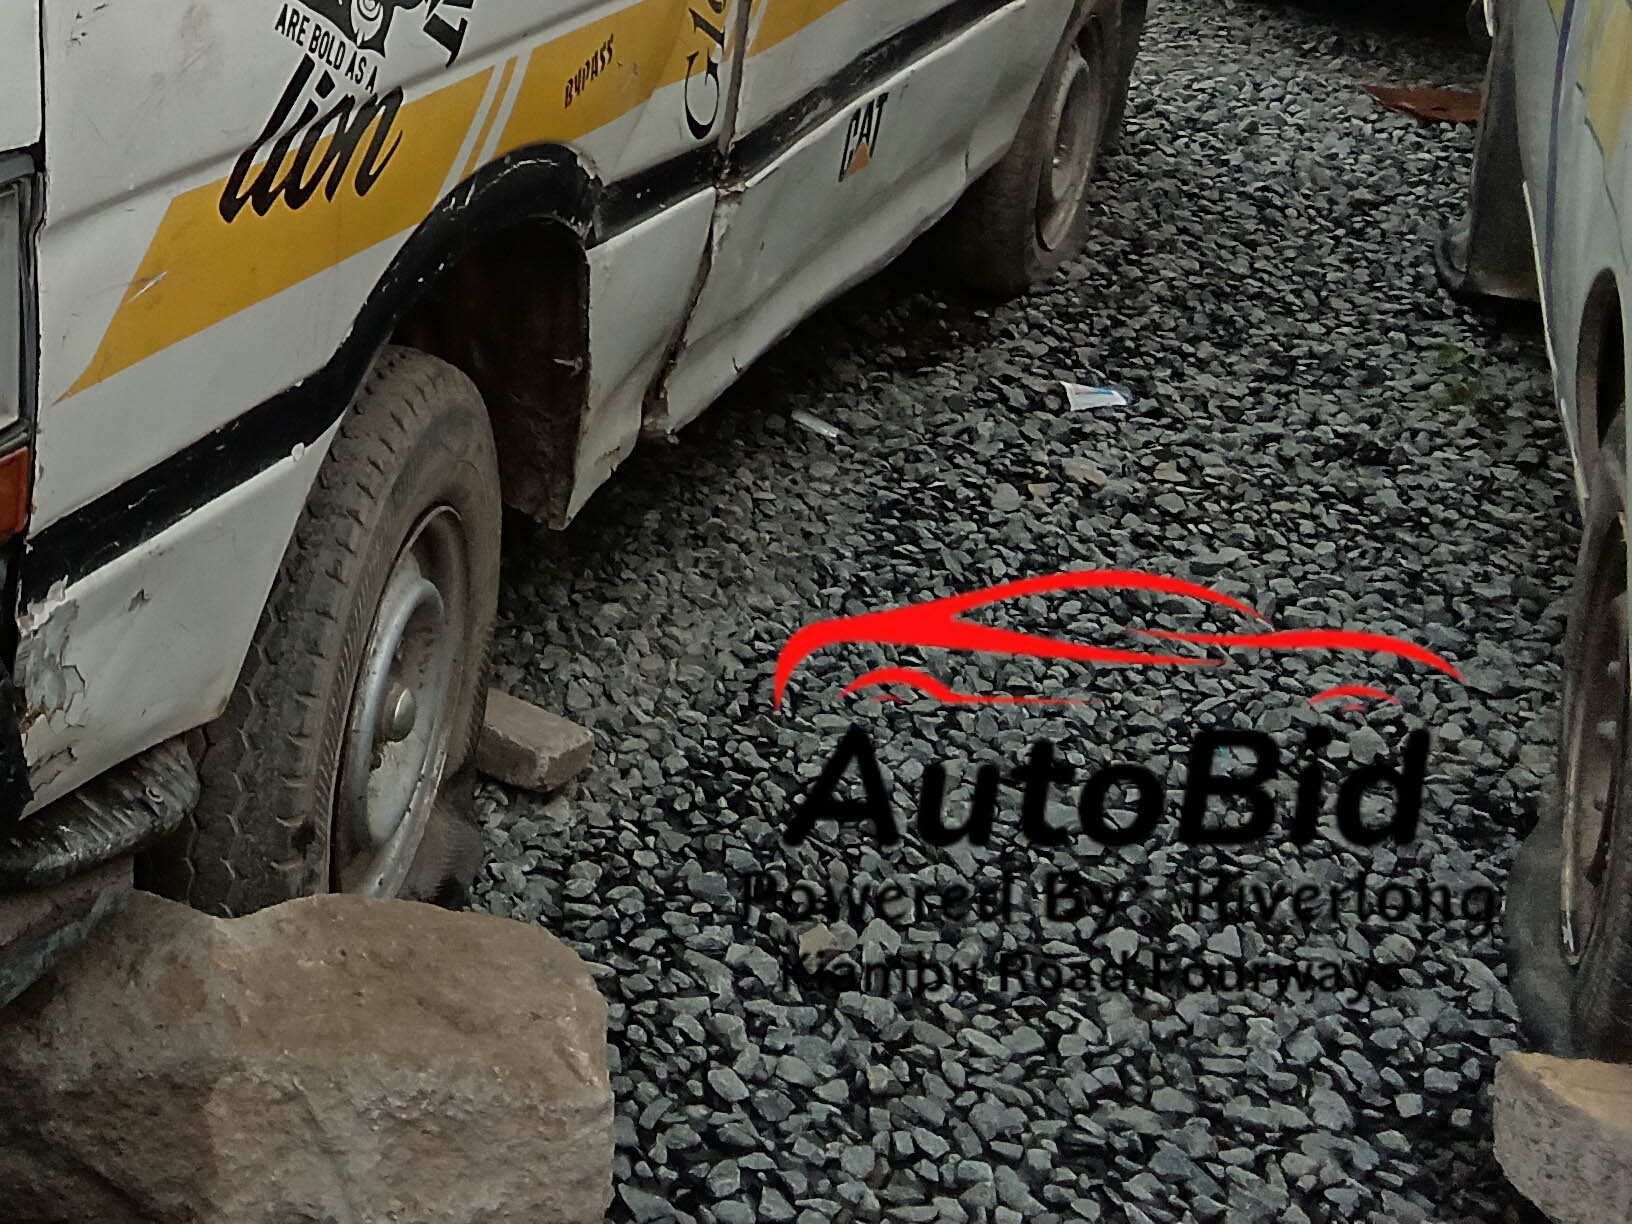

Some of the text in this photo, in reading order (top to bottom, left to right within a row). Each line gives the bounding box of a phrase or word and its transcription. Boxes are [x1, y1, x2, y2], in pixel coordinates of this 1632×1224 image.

[274, 3, 379, 94] ARE BOLD AS A
[564, 33, 614, 109] BYPASS
[219, 53, 404, 224] lion
[838, 92, 889, 183] CAT
